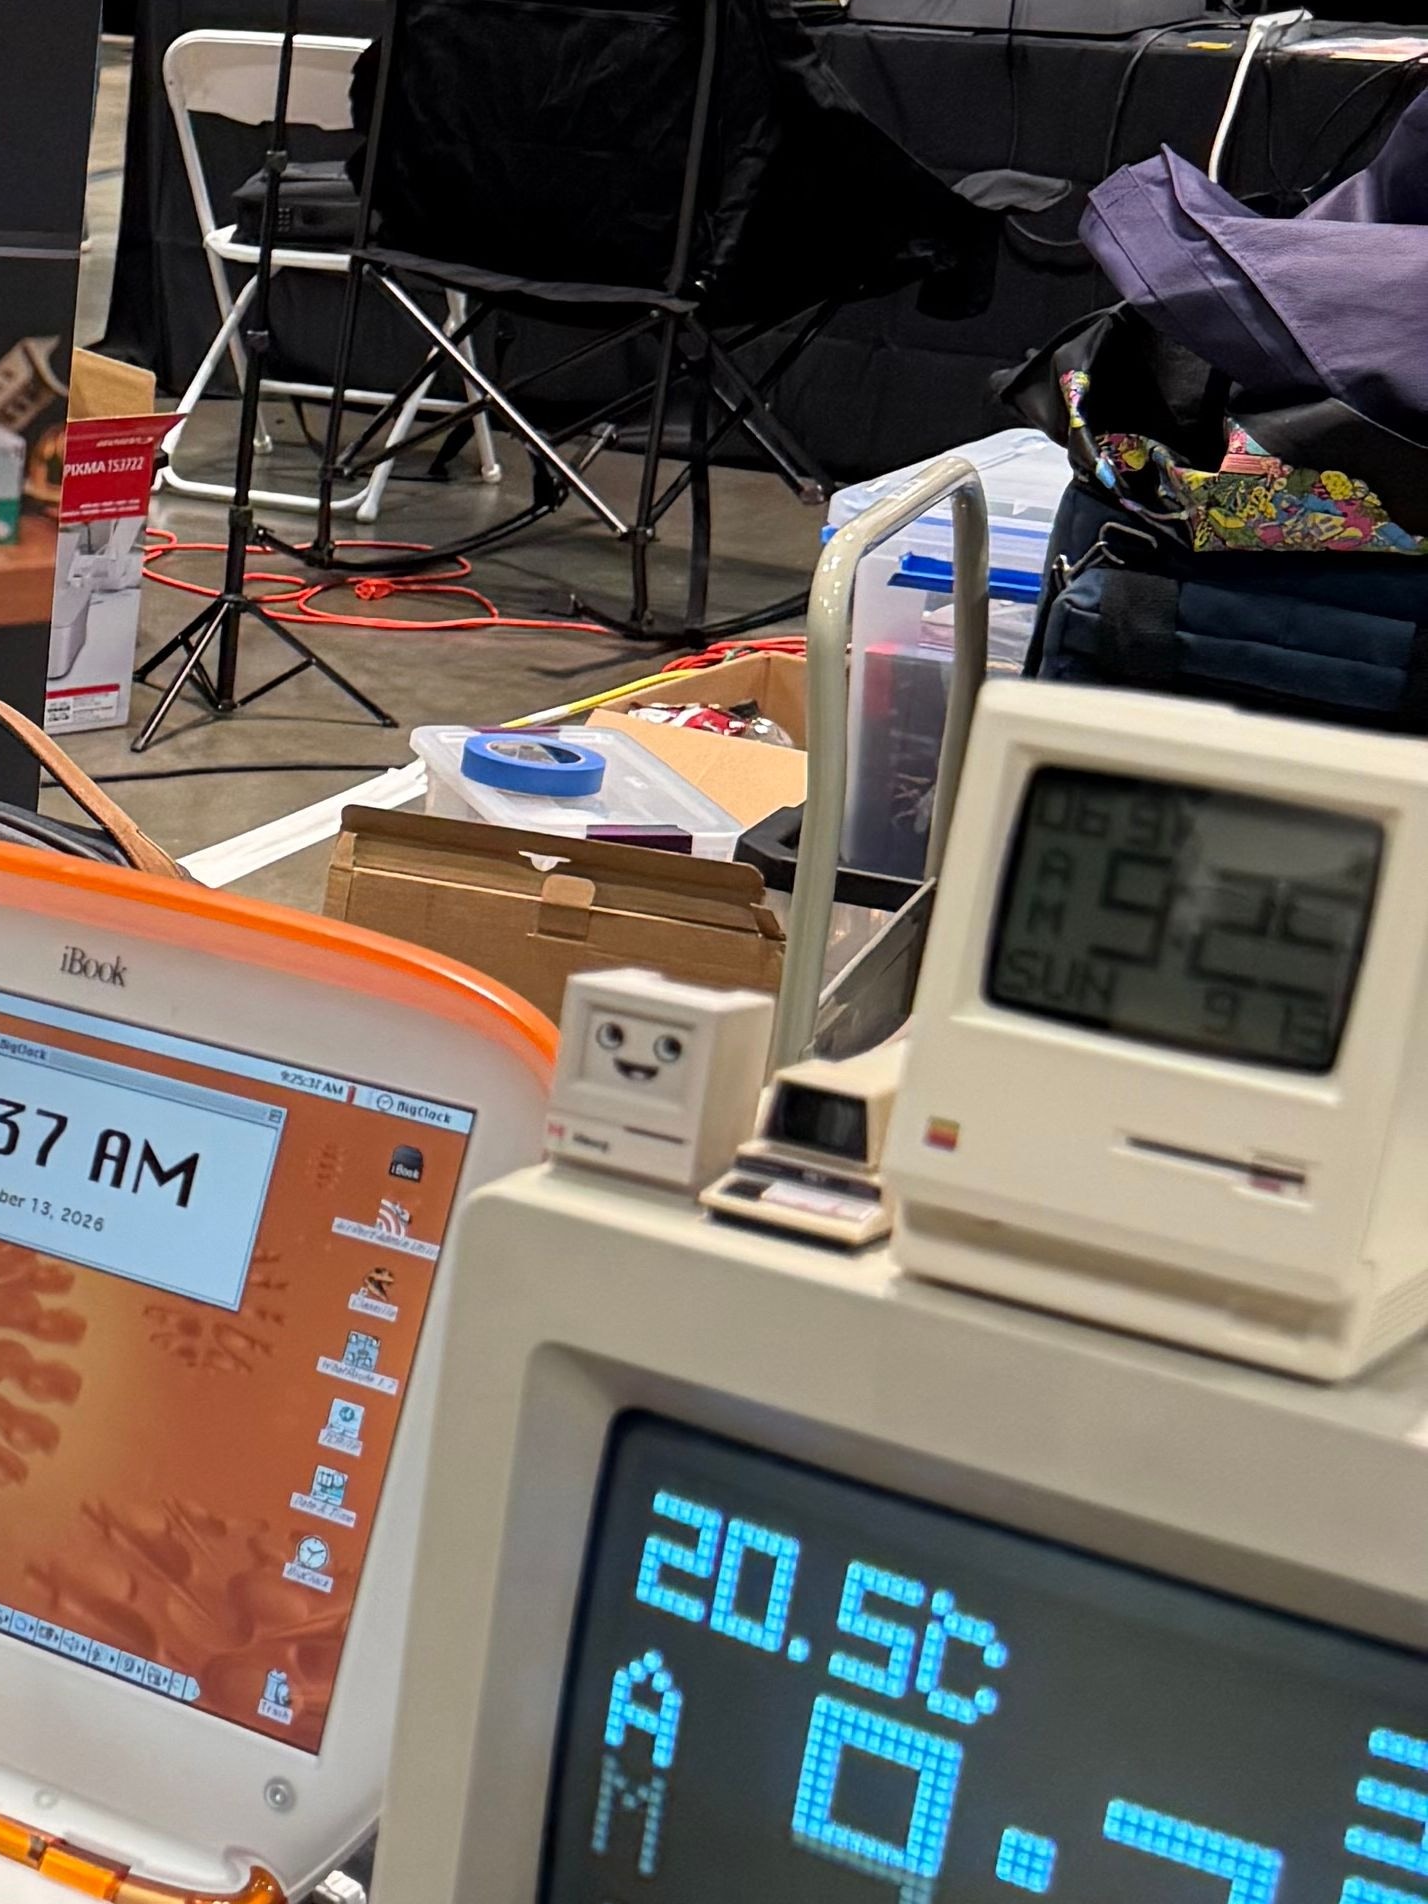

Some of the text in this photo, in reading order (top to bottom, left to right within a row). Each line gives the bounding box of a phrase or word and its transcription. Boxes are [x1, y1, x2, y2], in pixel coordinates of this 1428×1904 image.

[63, 458, 106, 477] PIXMA
[59, 945, 128, 988] iBook
[396, 1101, 452, 1124] BigClock
[88, 1127, 200, 1208] AM
[31, 1197, 54, 1220] 13,
[60, 1207, 106, 1233] 2026
